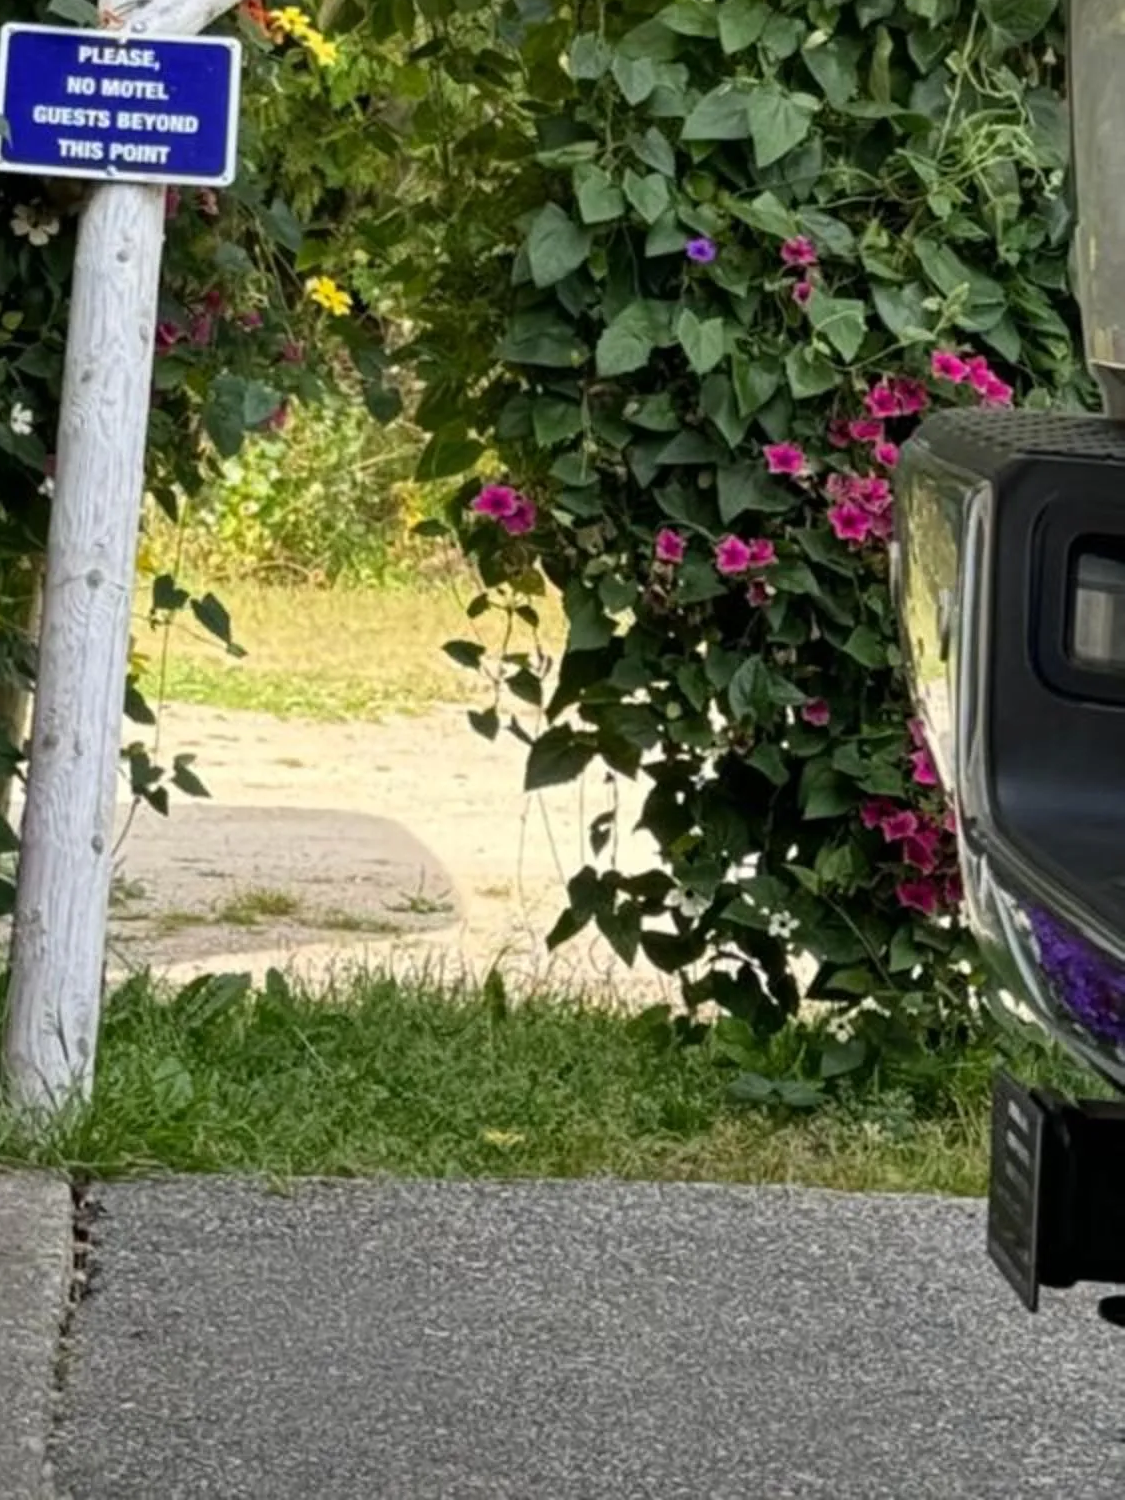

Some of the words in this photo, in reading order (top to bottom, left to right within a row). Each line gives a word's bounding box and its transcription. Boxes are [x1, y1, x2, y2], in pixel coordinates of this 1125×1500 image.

[78, 46, 161, 71] PLEASE,
[66, 76, 95, 95] NO
[101, 79, 169, 100] MOTEL
[33, 105, 111, 128] GUESTS
[116, 112, 199, 133] BEYOND
[58, 138, 103, 160] THIS
[109, 143, 171, 164] POINT
